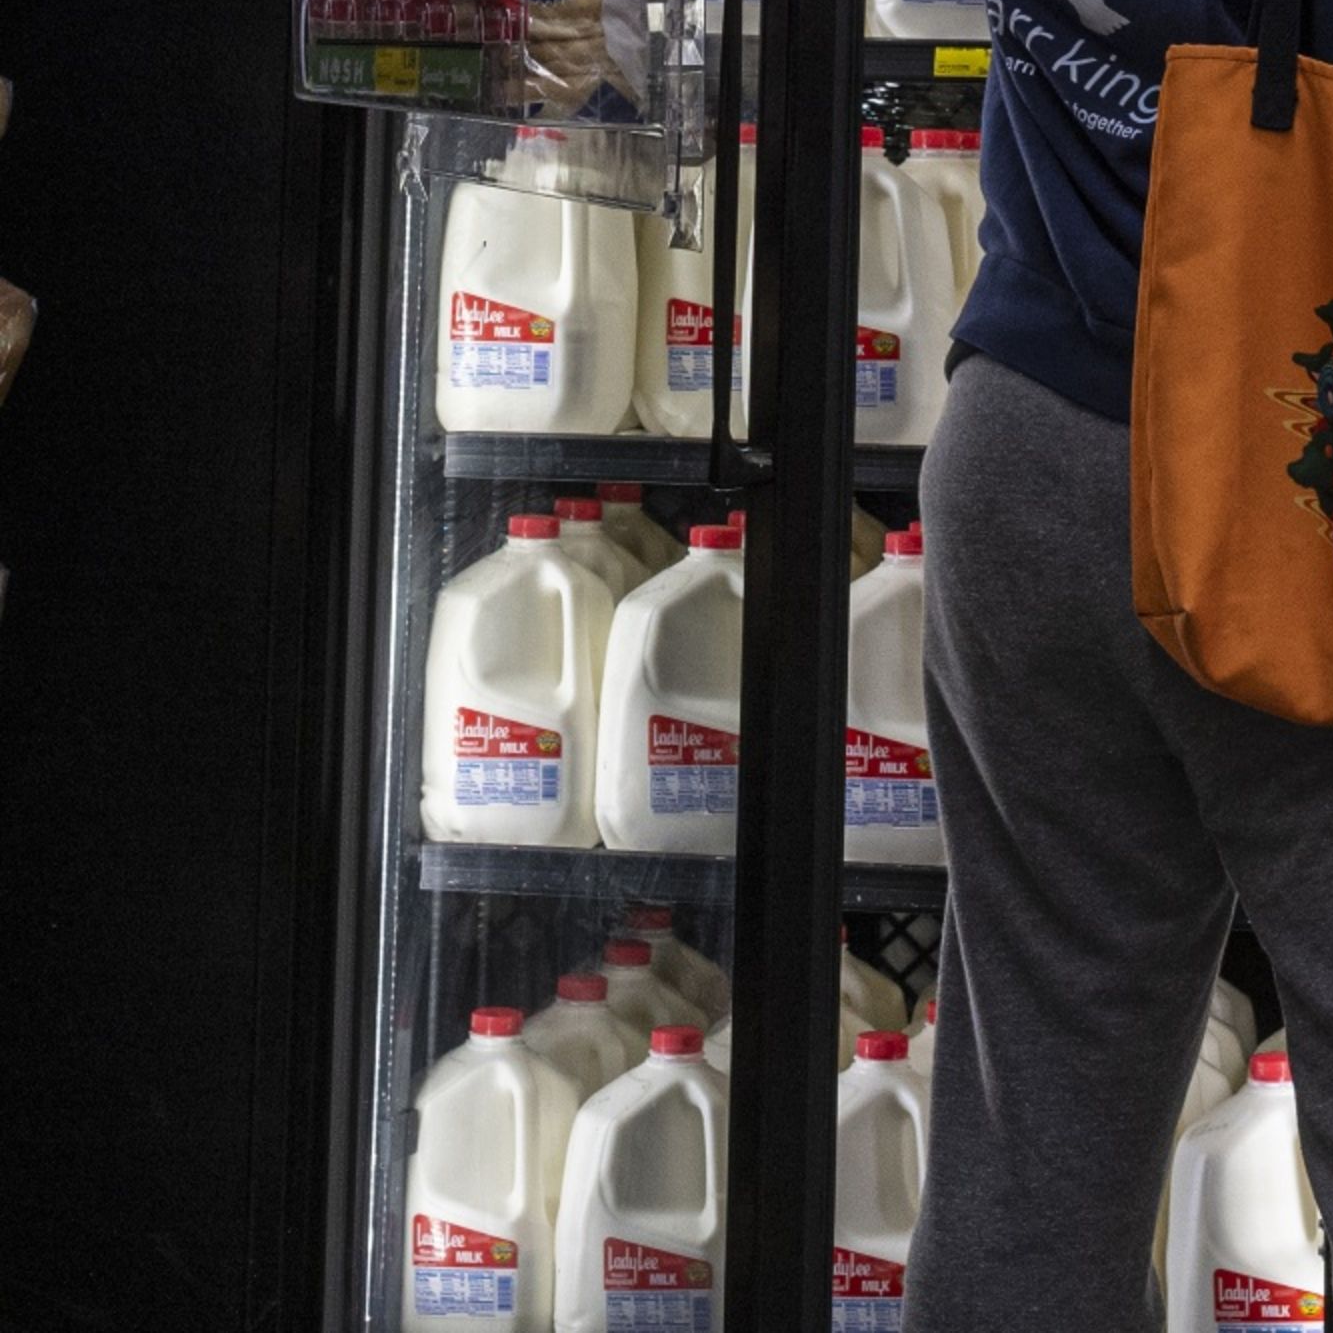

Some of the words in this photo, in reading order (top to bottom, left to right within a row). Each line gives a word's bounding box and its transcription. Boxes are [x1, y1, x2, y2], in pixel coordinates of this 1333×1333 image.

[1072, 103, 1143, 140] together
[500, 743, 529, 755] MILK
[652, 726, 705, 760] LadyLee
[607, 1248, 660, 1287] LadyLee
[1218, 1277, 1271, 1317] LadyLee
[1261, 1305, 1290, 1317] MILK
